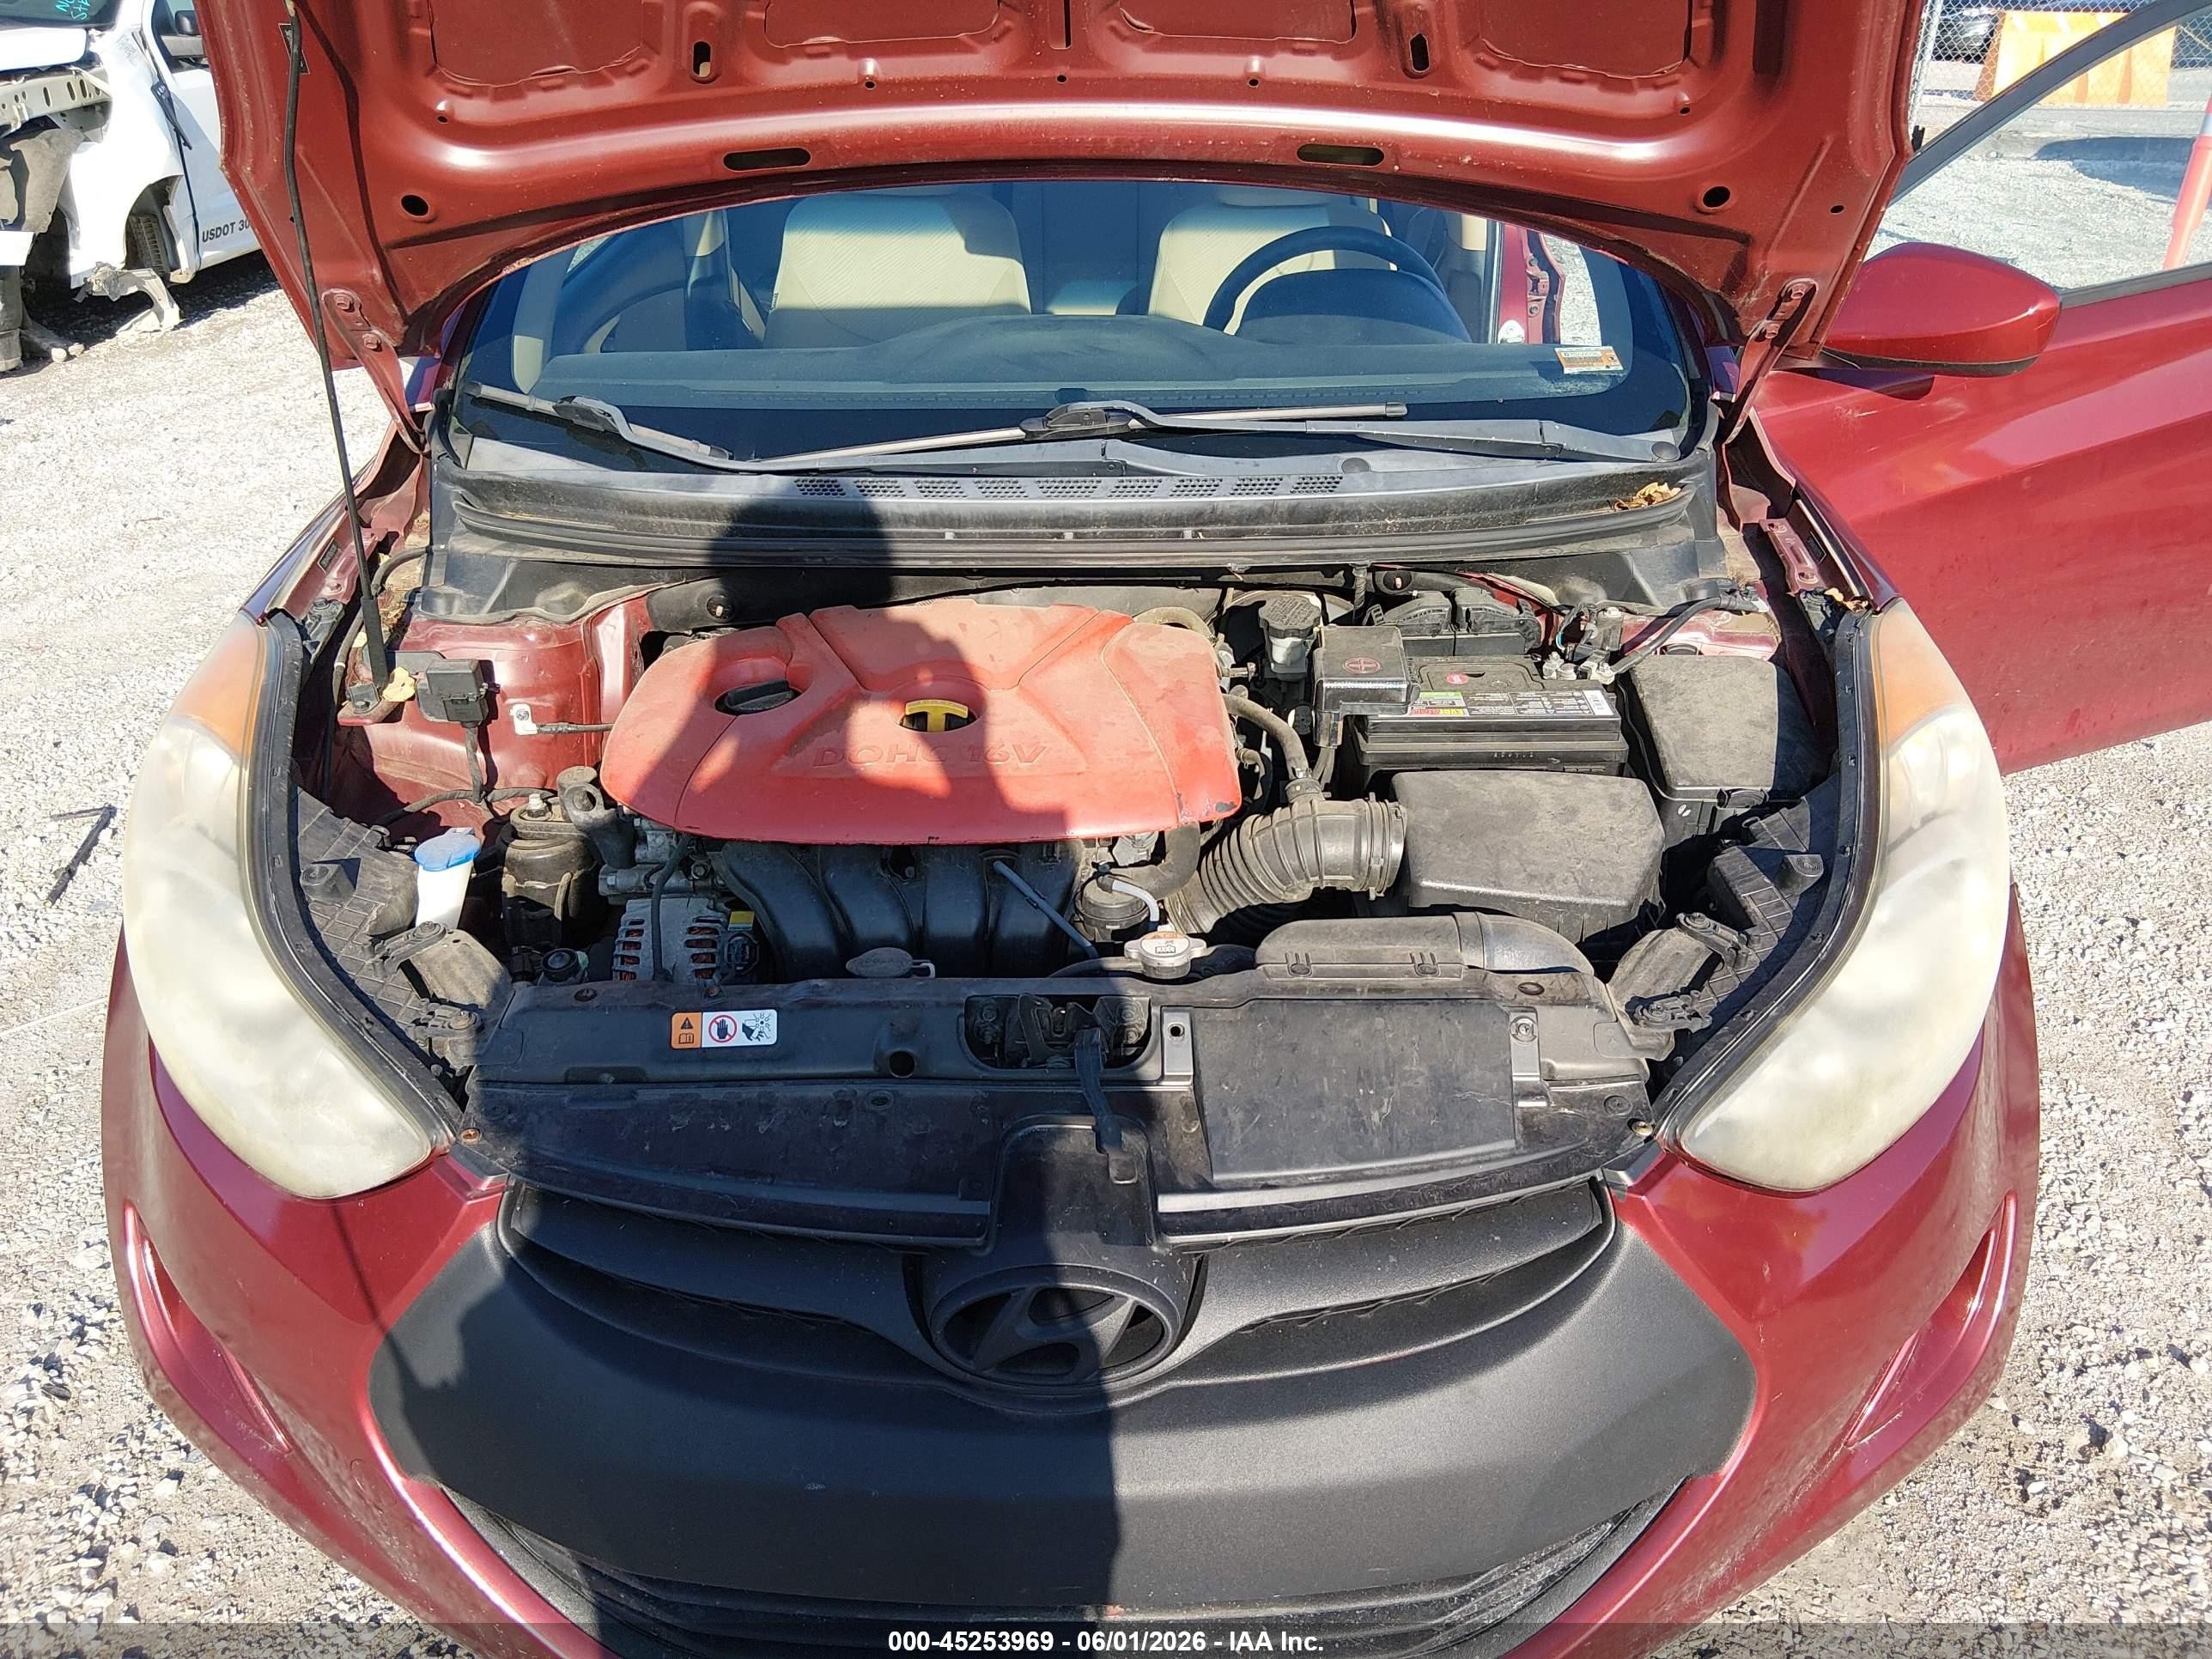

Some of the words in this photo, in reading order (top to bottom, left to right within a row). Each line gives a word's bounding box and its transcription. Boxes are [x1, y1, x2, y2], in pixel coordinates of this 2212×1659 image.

[202, 221, 236, 243] USDOT
[812, 743, 949, 767] DOHC
[967, 741, 1048, 764] 16V
